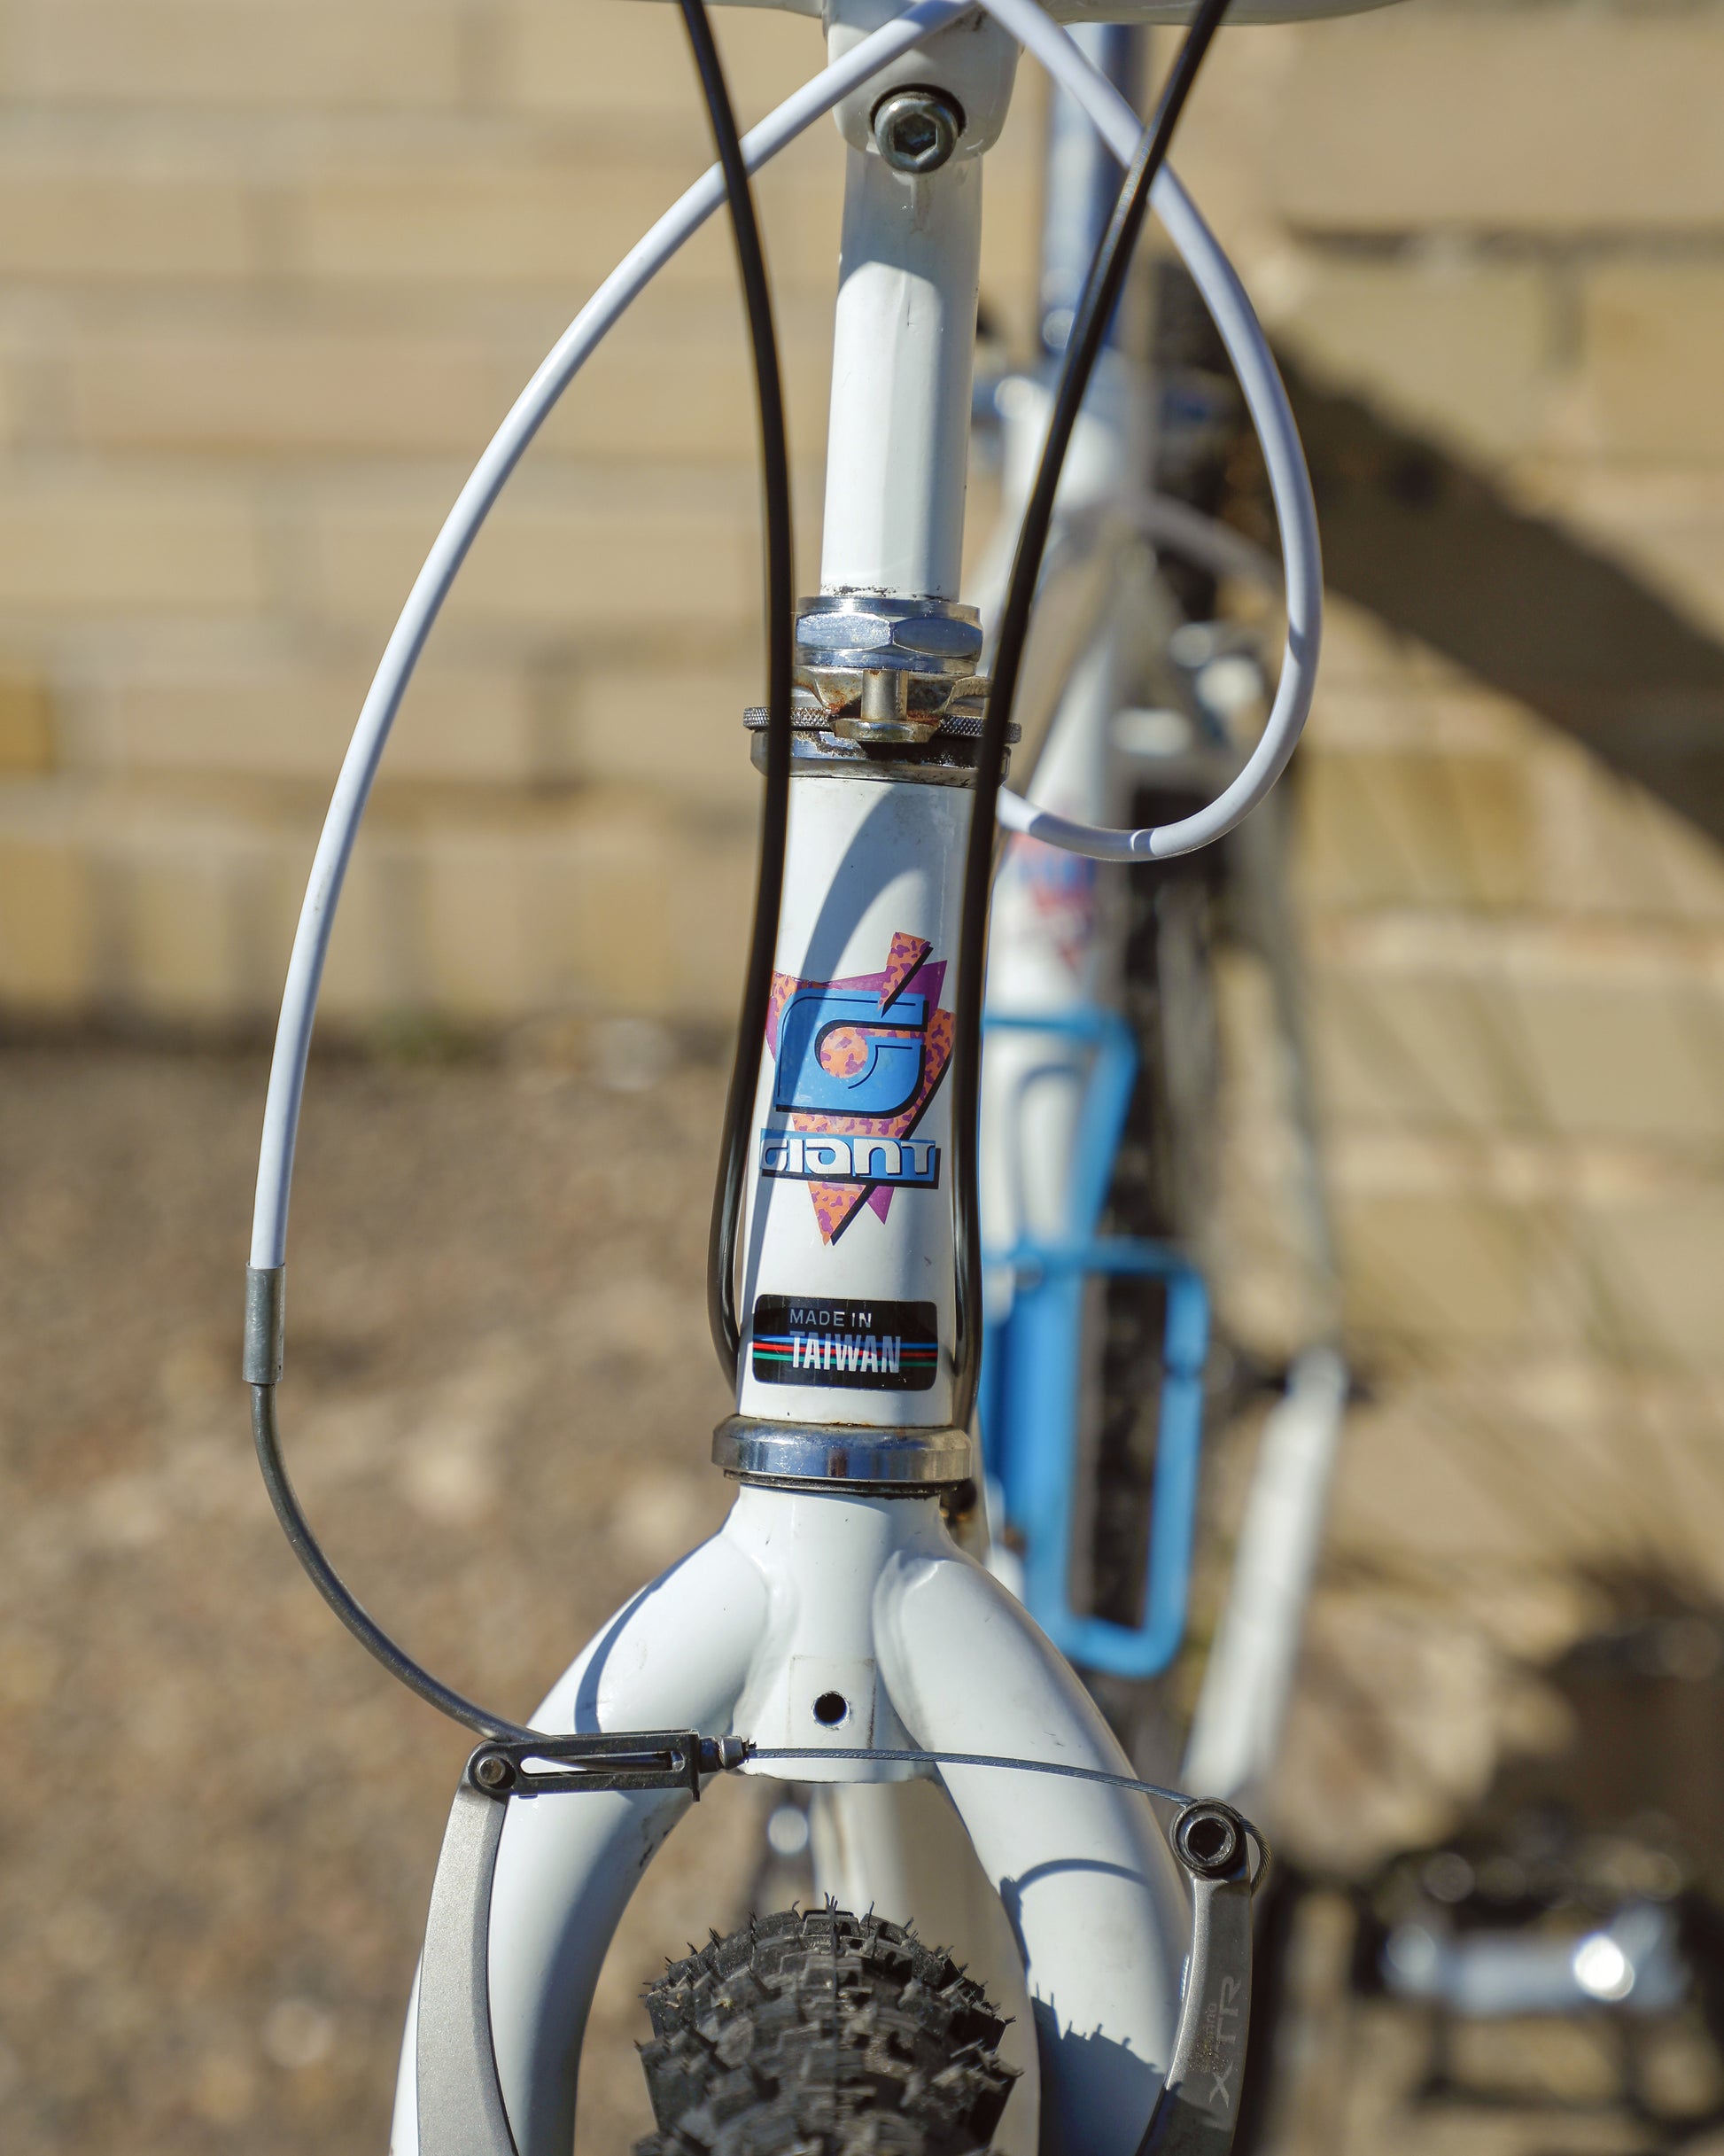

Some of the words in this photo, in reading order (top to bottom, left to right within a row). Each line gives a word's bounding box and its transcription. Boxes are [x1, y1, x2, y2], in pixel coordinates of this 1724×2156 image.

[789, 1308, 845, 1327] MADE
[851, 1312, 872, 1328] IN
[789, 1330, 901, 1374] TAIWAN
[1208, 1976, 1240, 2108] XTR
